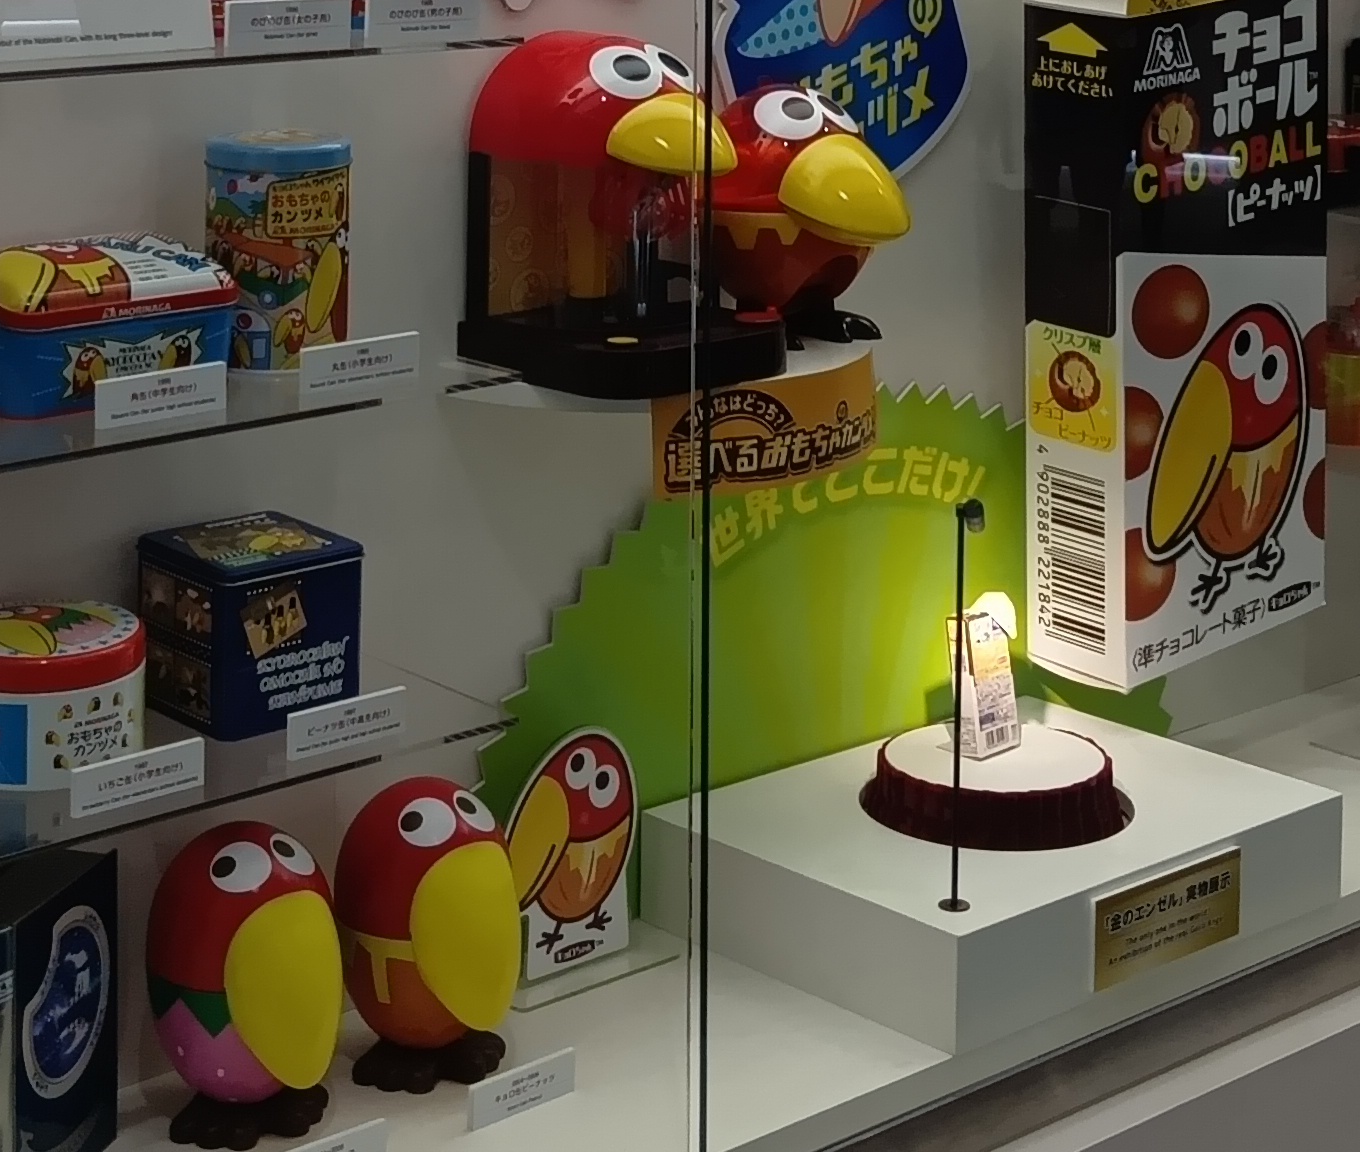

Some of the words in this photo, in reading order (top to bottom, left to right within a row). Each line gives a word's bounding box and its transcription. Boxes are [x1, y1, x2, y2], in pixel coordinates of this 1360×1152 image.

[1036, 55, 1108, 81] 上におしあげ
[1134, 66, 1200, 93] MORINAGA
[1031, 71, 1113, 98] あけてください
[1212, 58, 1318, 138] ボール
[1133, 120, 1322, 204] CHOCOBALL
[118, 302, 171, 317] MORINAGA
[1043, 326, 1102, 355] クリスプ層
[1032, 401, 1064, 421] チョコ
[1058, 424, 1111, 450] ピーナッツ
[67, 720, 122, 745] おもちゃの
